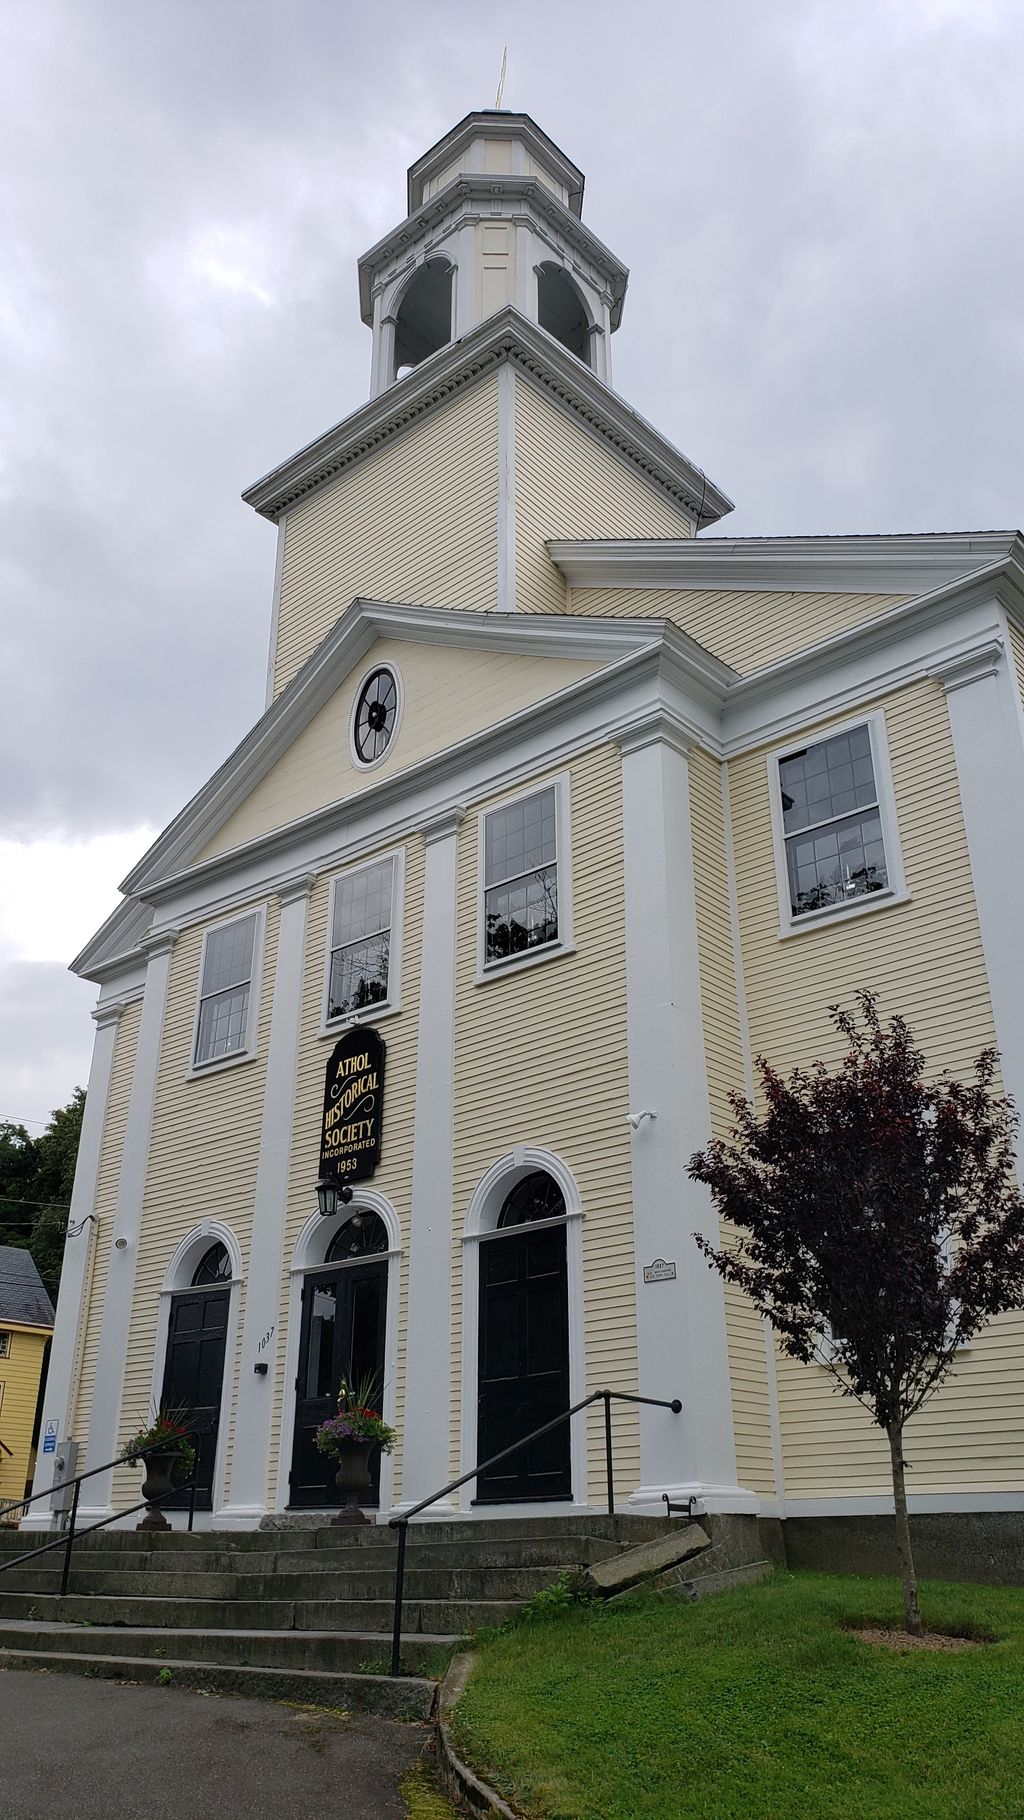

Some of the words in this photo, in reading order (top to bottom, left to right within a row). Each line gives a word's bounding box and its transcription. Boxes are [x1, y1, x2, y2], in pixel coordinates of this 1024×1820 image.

[336, 1052, 372, 1079] ATHOL
[325, 1072, 379, 1130] HISTORICAL
[325, 1118, 375, 1148] SOCIETY
[322, 1138, 376, 1160] INCORPORATED
[337, 1157, 358, 1174] 1953
[258, 1326, 275, 1353] 1037
